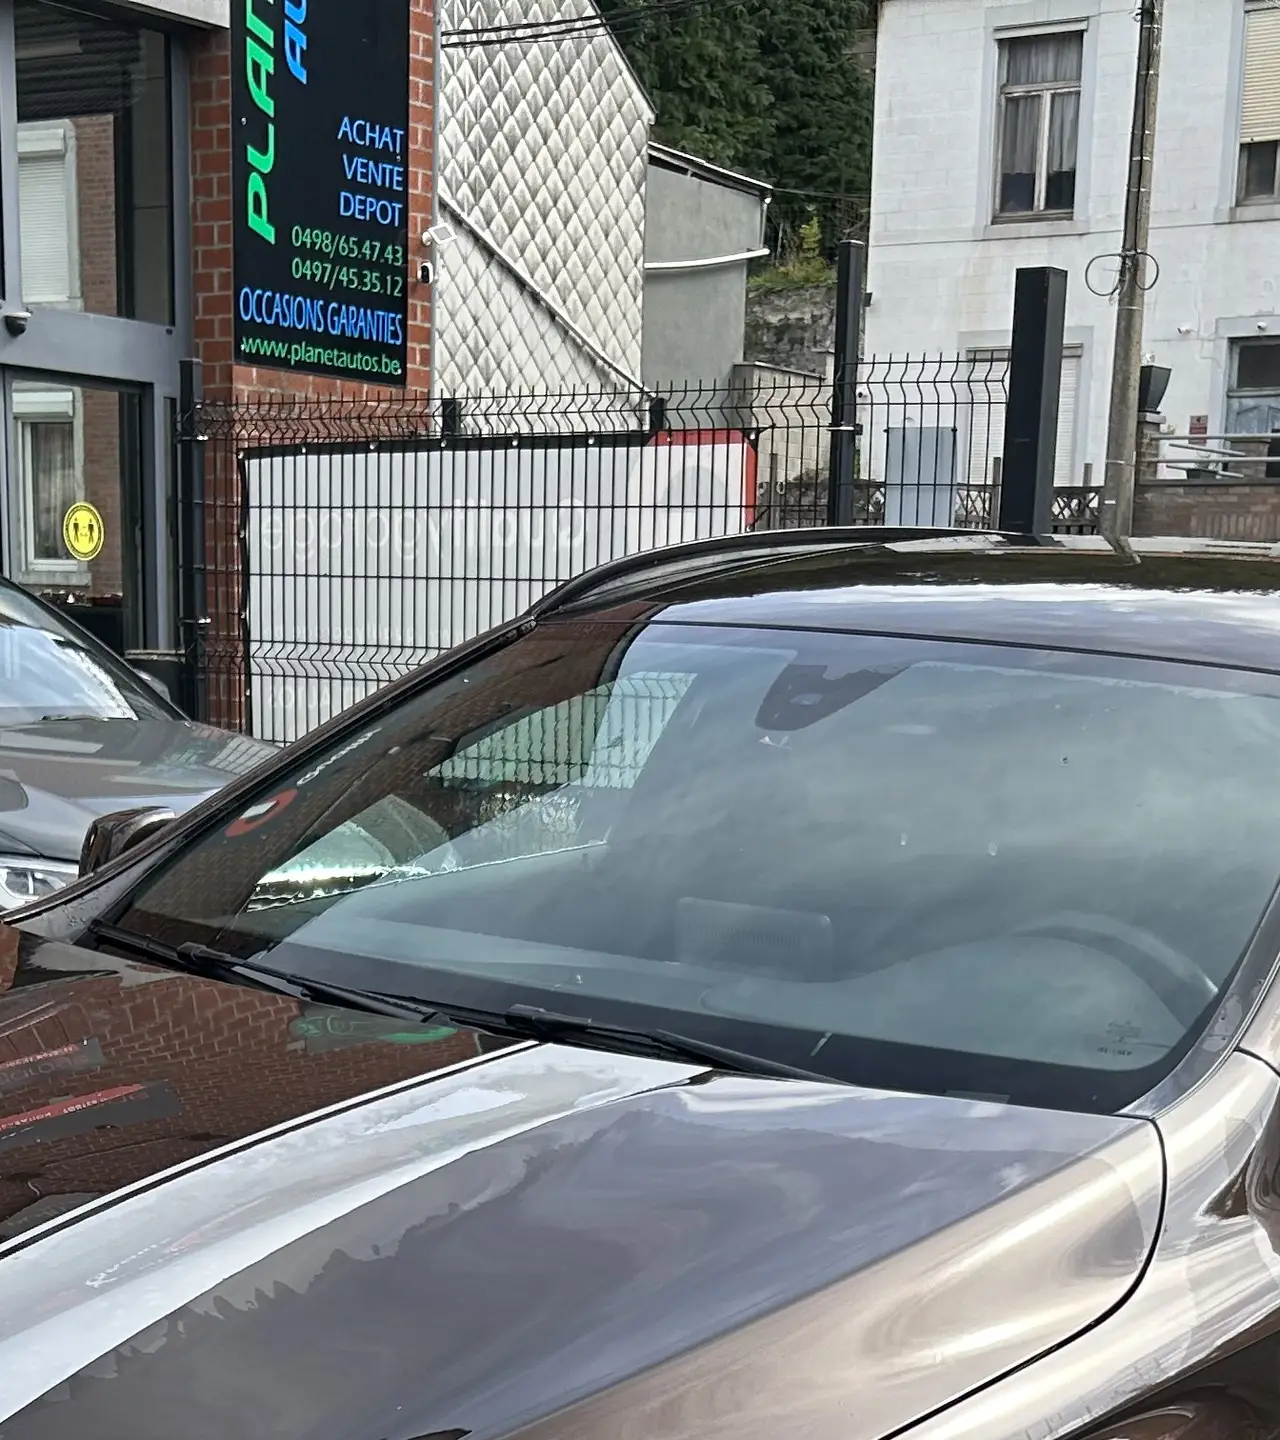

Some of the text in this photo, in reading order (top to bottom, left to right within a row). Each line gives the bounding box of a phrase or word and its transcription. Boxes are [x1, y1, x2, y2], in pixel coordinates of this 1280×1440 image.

[337, 116, 404, 154] ACHAT
[342, 153, 404, 191] VENTE
[339, 191, 403, 227] DEPOT
[291, 225, 403, 267] 0498/65.47.43
[291, 257, 403, 298] 0497/45.35.12
[239, 287, 403, 345] OCCASIONS GARANTIES
[241, 335, 402, 376] www.planetautos.be
